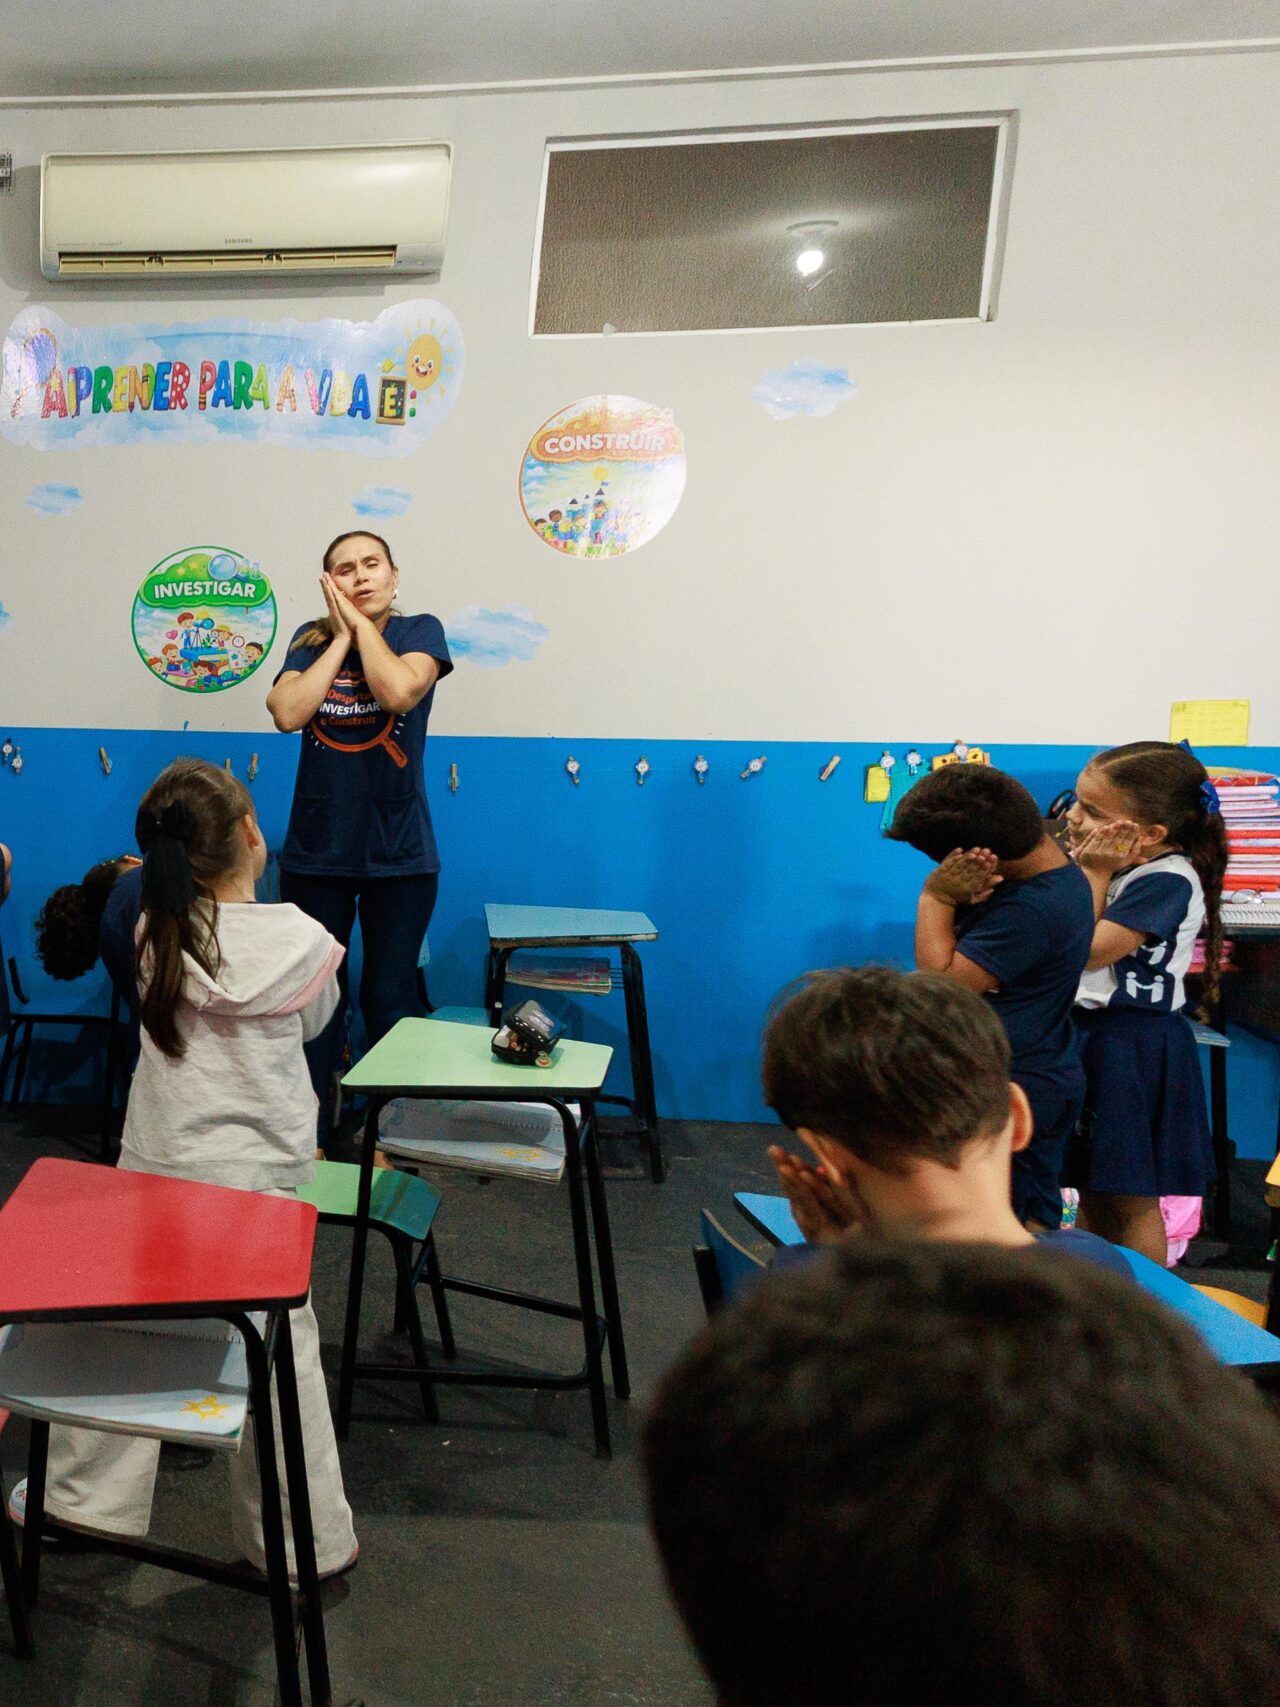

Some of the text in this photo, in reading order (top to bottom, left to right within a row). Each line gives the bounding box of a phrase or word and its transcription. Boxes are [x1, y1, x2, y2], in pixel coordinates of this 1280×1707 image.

[198, 360, 271, 411] PARA
[275, 365, 298, 413] A
[543, 431, 666, 454] CONSTRUIR
[153, 580, 257, 599] INVESTIGAR
